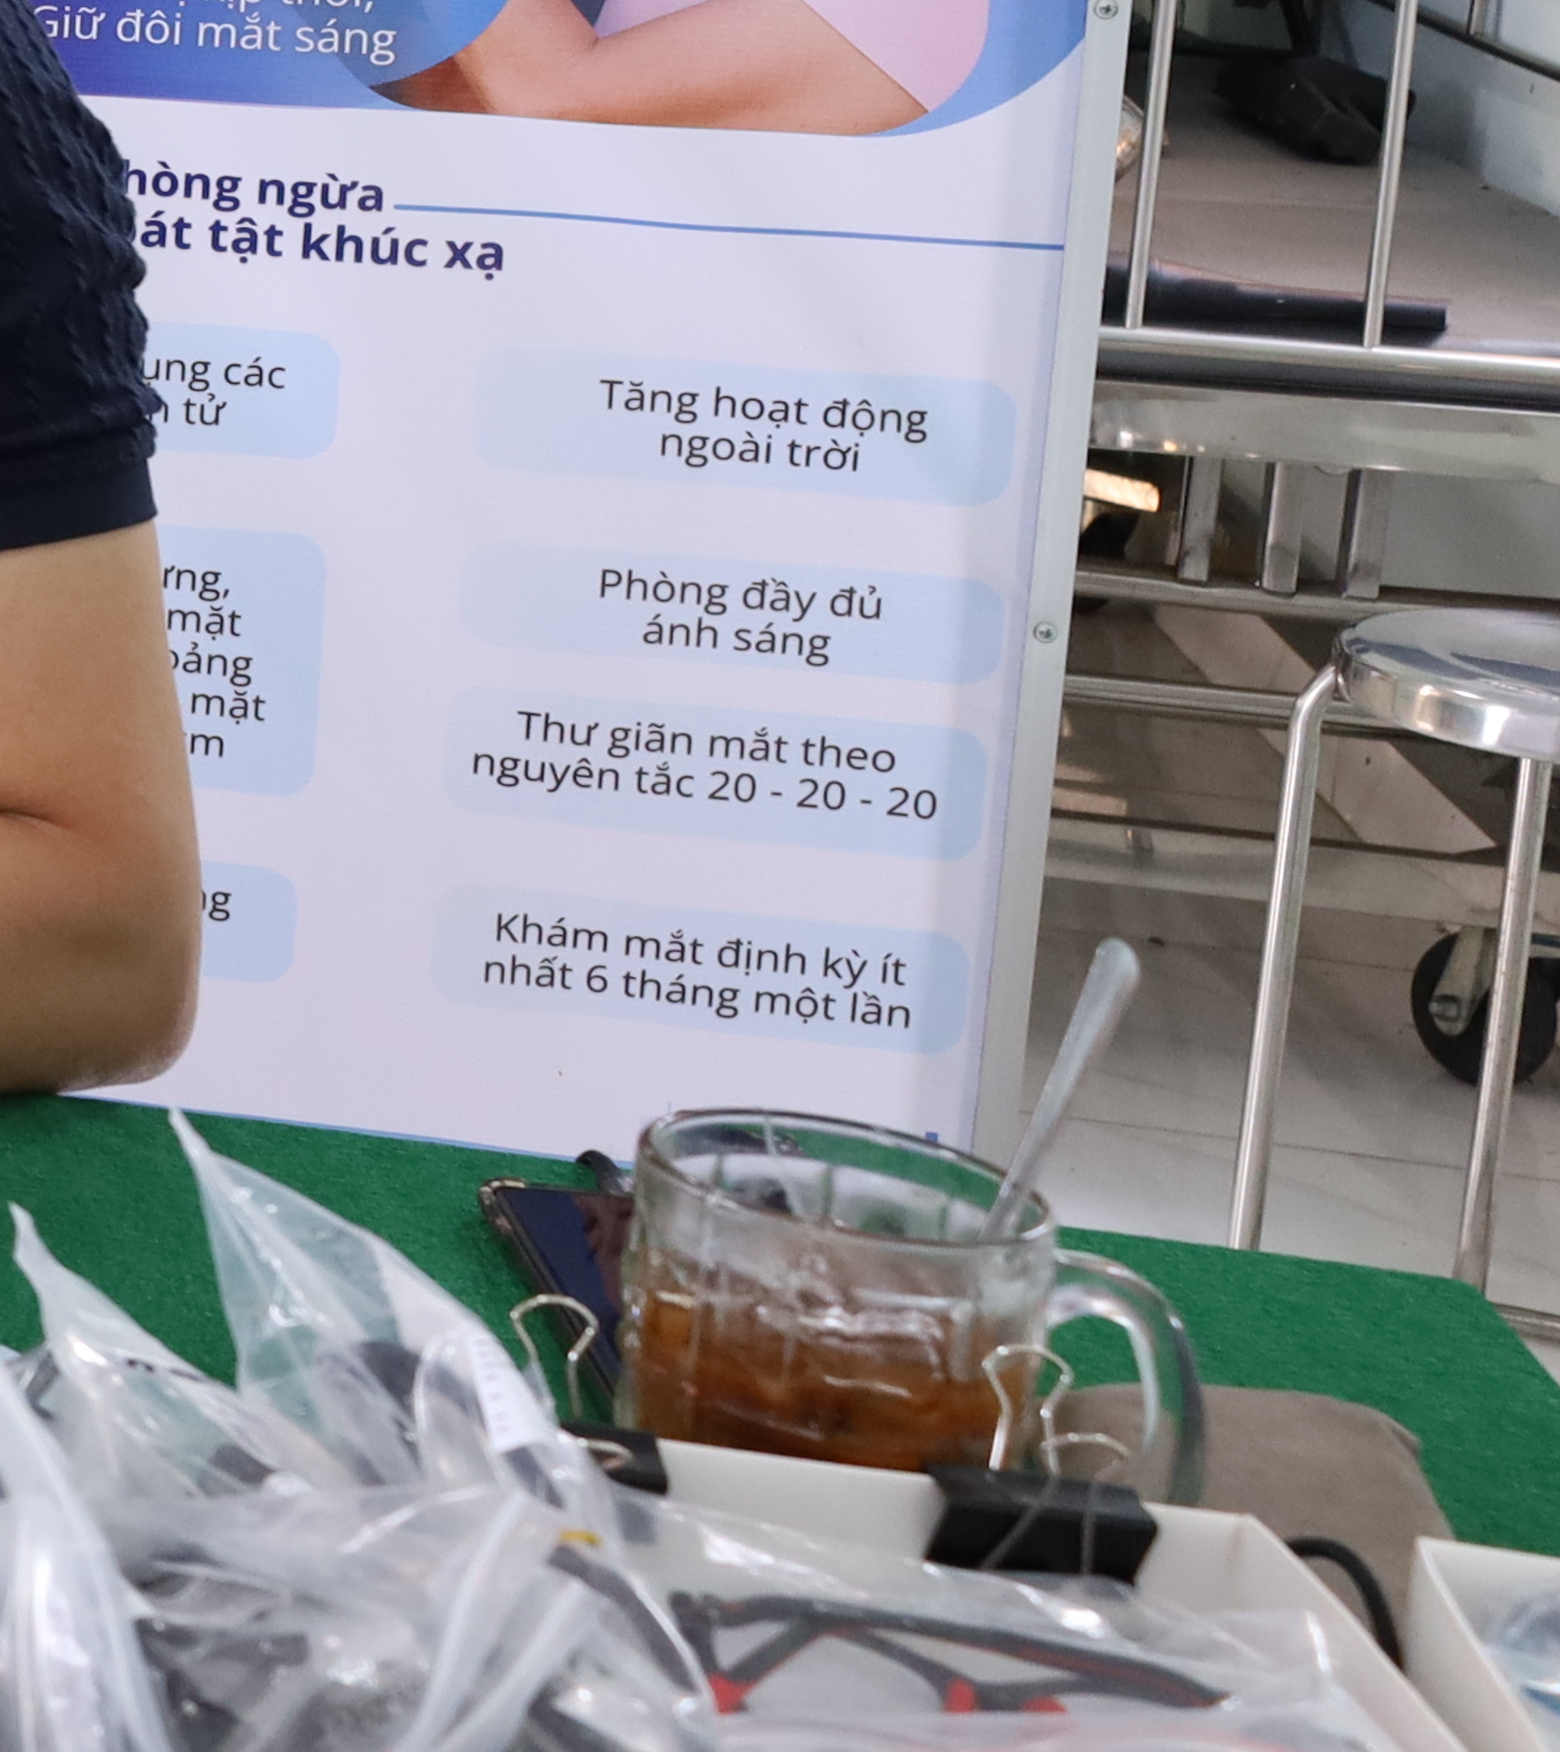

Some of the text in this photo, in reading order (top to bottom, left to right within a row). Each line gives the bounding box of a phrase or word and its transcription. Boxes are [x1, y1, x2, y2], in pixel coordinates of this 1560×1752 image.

[116, 8, 182, 47] đôi
[197, 13, 282, 52] mắt
[295, 18, 397, 66] sáng
[122, 159, 385, 218] hòng ngừa
[133, 211, 504, 281] át tật khúc xạ
[141, 356, 286, 392] ụng các
[183, 392, 227, 426] tử
[600, 378, 928, 444] Tăng hoạt động
[660, 430, 860, 472] ngoài trời
[167, 605, 242, 641] mặt
[599, 568, 883, 623] Phòng đầy đủ
[642, 613, 831, 668] ánh sáng
[190, 689, 266, 726] mặt
[184, 732, 224, 758] m
[518, 710, 896, 774] Thư giãn mắt theo
[472, 751, 620, 793] nguyên
[635, 761, 695, 799] tắc
[707, 770, 757, 804] 20
[796, 778, 847, 812] 20
[885, 786, 938, 821] 20
[495, 912, 907, 990] Khám mắt định kỳ ít
[483, 953, 912, 1031] nhất 6 tháng một lần
